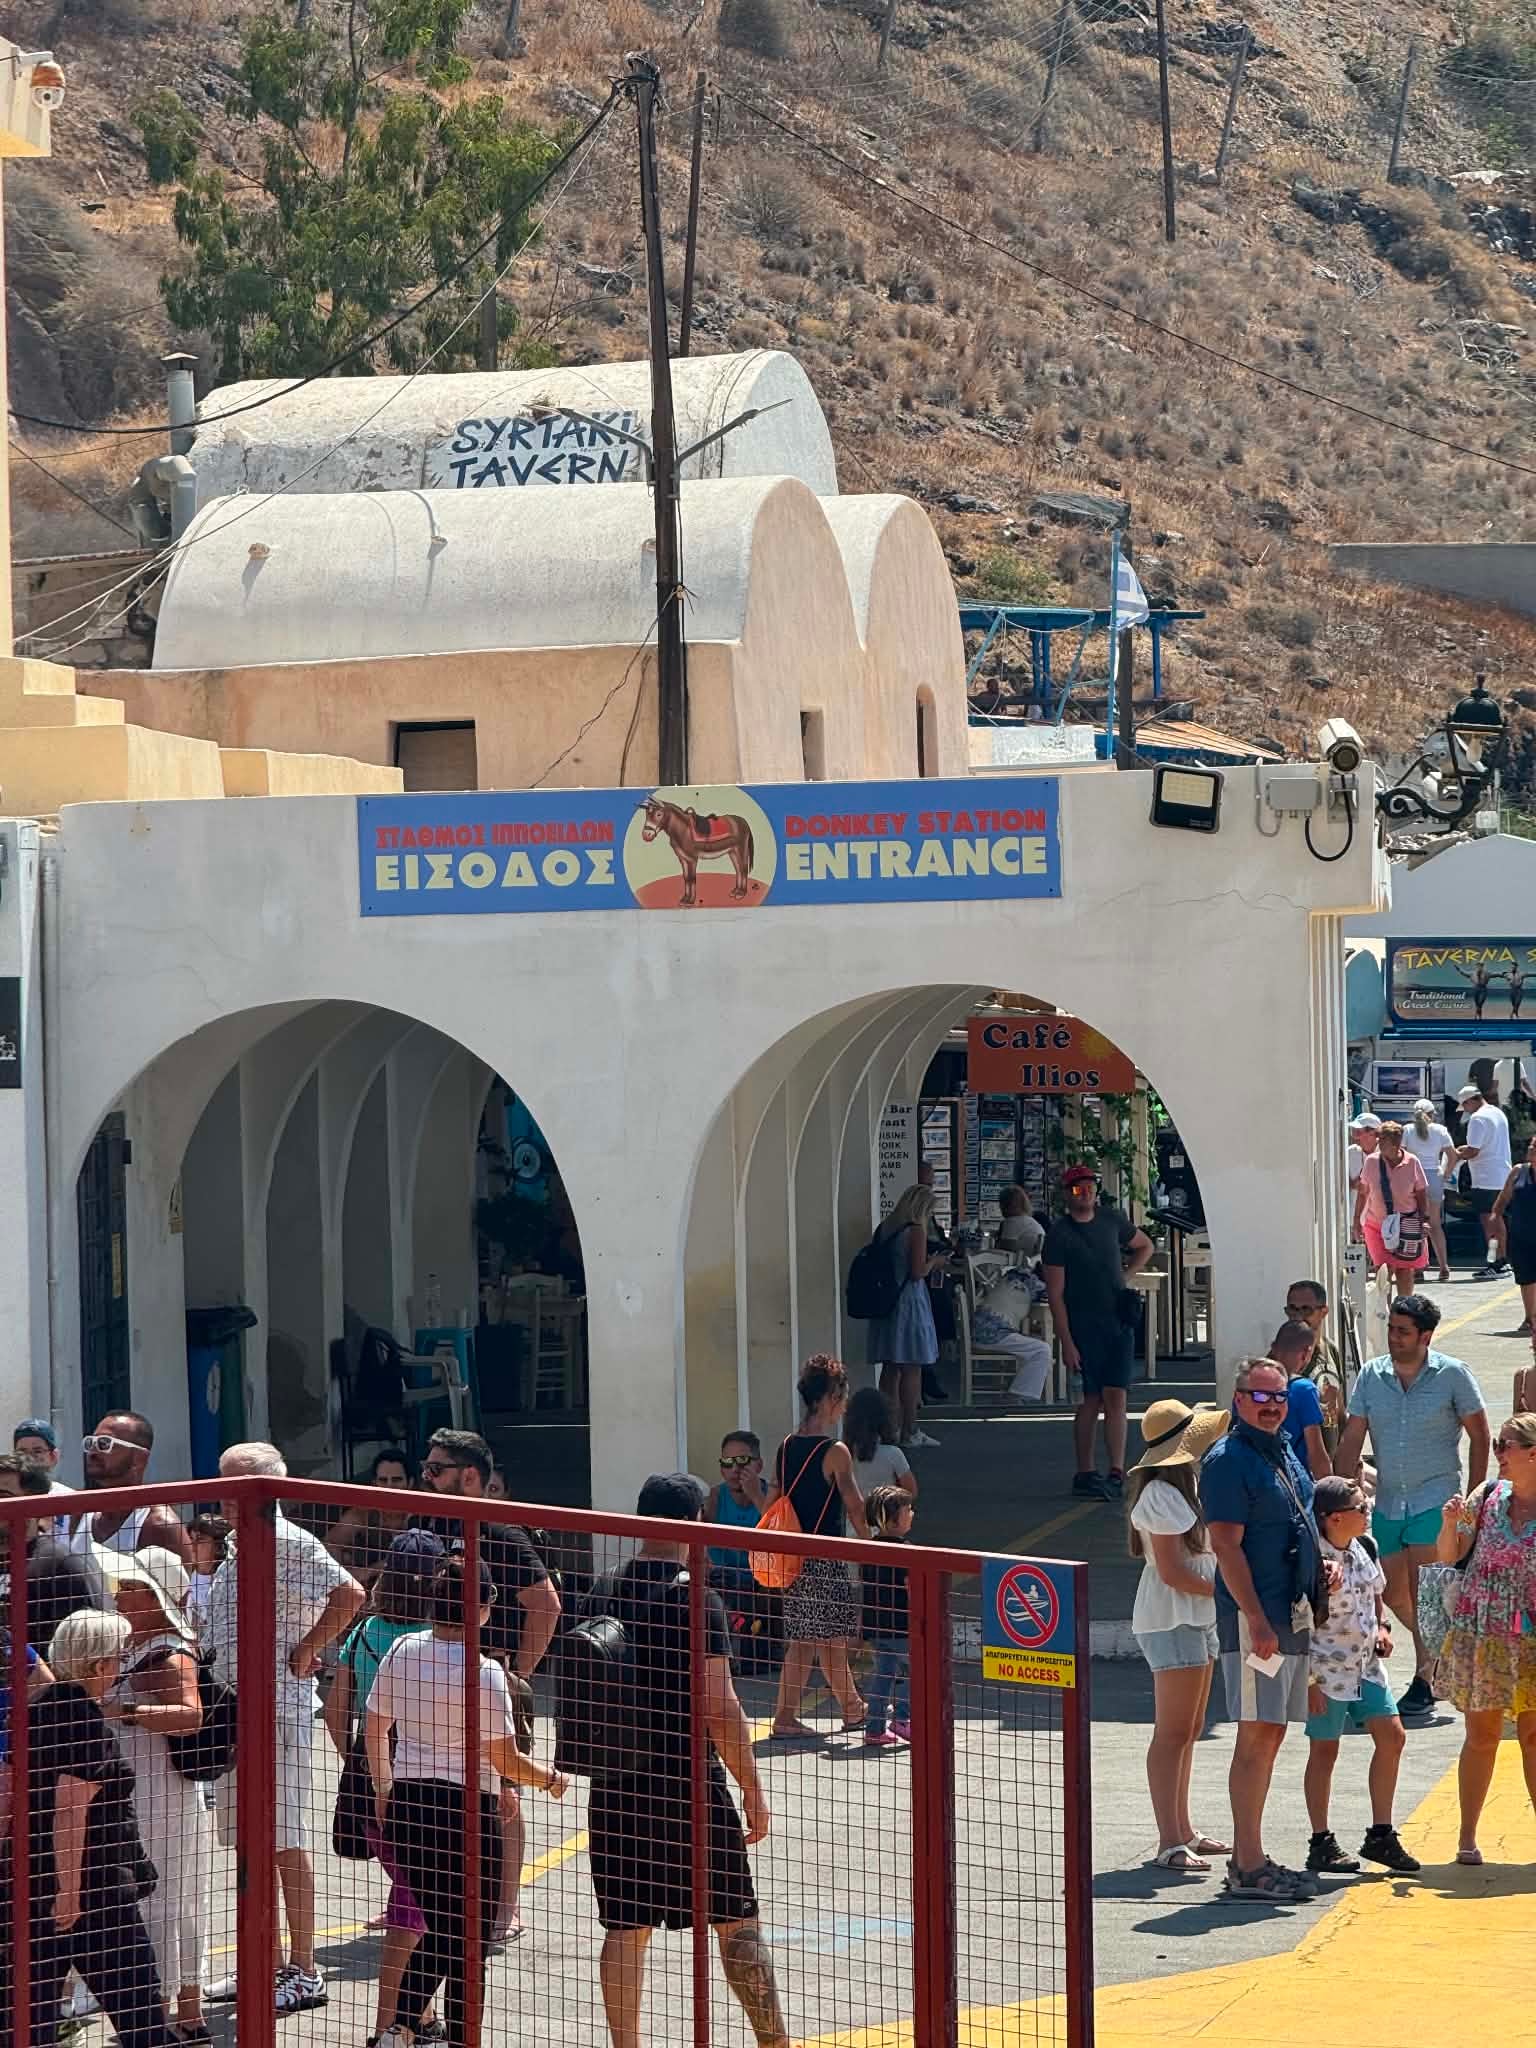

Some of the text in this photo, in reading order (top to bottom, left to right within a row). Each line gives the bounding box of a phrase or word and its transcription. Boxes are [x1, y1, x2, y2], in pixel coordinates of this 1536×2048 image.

[785, 808, 1046, 838] DONKEY STATION
[375, 824, 485, 849] ΣΤΑΘΜΟΣ
[375, 849, 616, 891] ΕΙΣΟΔΟΣ
[785, 836, 1048, 881] ENTRANCE
[1401, 947, 1515, 969] TAVERNA
[1409, 990, 1466, 1000] Traditional
[983, 1023, 1071, 1049] Café
[1022, 1064, 1100, 1087] Ilios
[890, 1104, 912, 1114] Bar
[879, 1141, 902, 1150] ORK
[998, 1663, 1061, 1682] NO ACCESS
